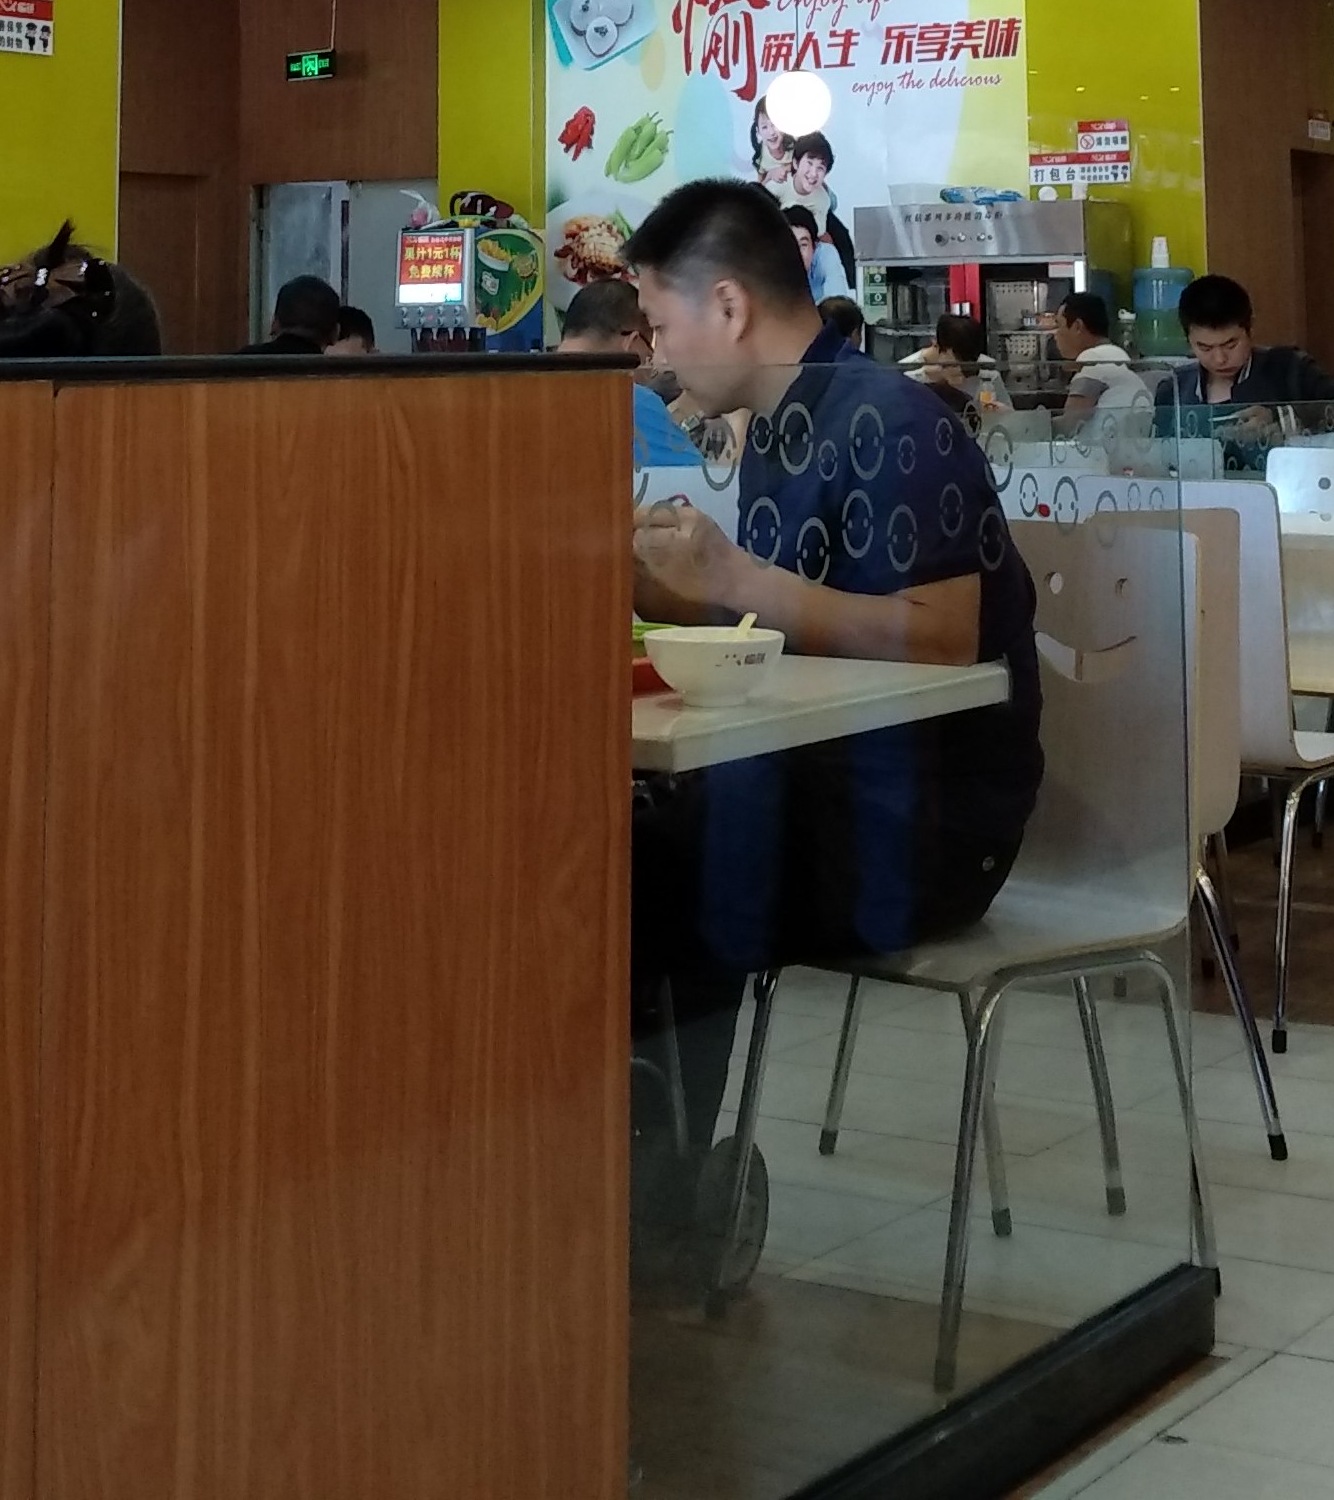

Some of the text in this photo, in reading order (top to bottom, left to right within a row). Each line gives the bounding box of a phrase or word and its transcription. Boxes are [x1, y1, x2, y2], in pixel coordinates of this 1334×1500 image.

[881, 17, 1022, 66] 乐享美味
[851, 66, 1002, 106] enjoy the delicious
[1034, 167, 1075, 183] 打包台
[404, 244, 460, 261] 果汁1元1杯
